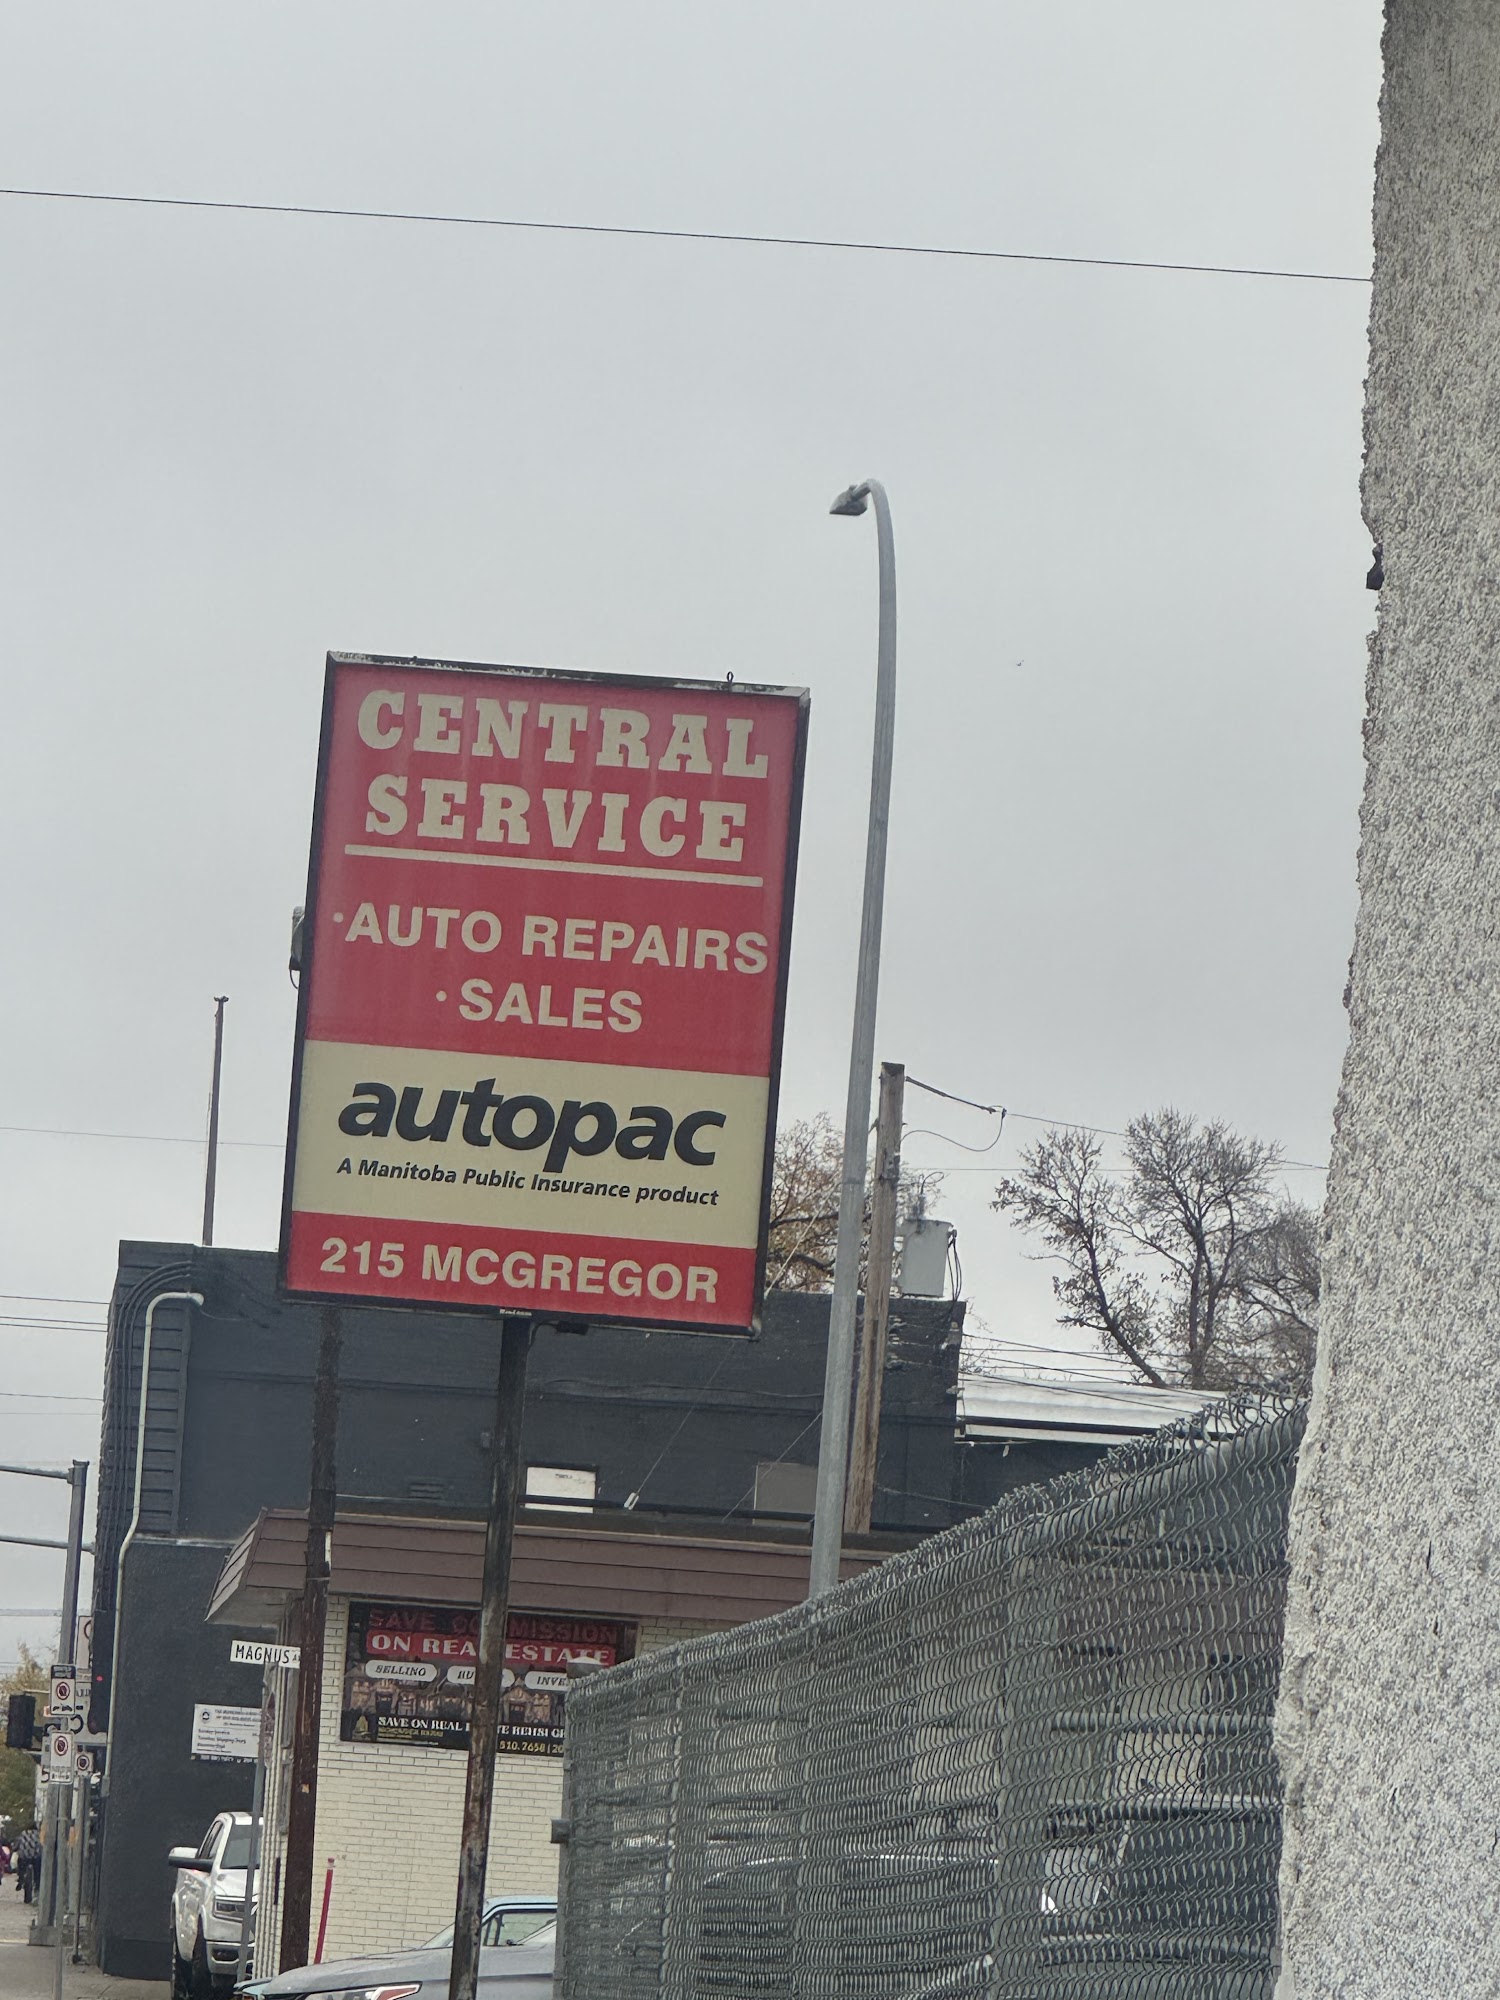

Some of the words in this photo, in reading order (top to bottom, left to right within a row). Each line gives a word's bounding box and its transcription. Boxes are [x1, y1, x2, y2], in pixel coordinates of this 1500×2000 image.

[357, 689, 769, 779] CENTRAL
[364, 774, 748, 862] SERVICE
[345, 902, 502, 954] AUTO
[522, 915, 769, 975] REPAIRS
[458, 978, 643, 1033] SALES
[337, 1077, 727, 1173] autopac
[336, 1157, 353, 1175] A
[358, 1159, 457, 1185] Manitoba
[462, 1167, 526, 1190] Public
[530, 1172, 631, 1199] Insurance
[635, 1183, 720, 1206] product
[320, 1236, 405, 1278] 215
[421, 1244, 719, 1304] MCGREGOR
[235, 1644, 290, 1664] MAGNUS
[371, 1634, 411, 1652] ON
[422, 1638, 477, 1657] REA
[378, 1716, 409, 1728] SAVE
[411, 1718, 429, 1729] ON
